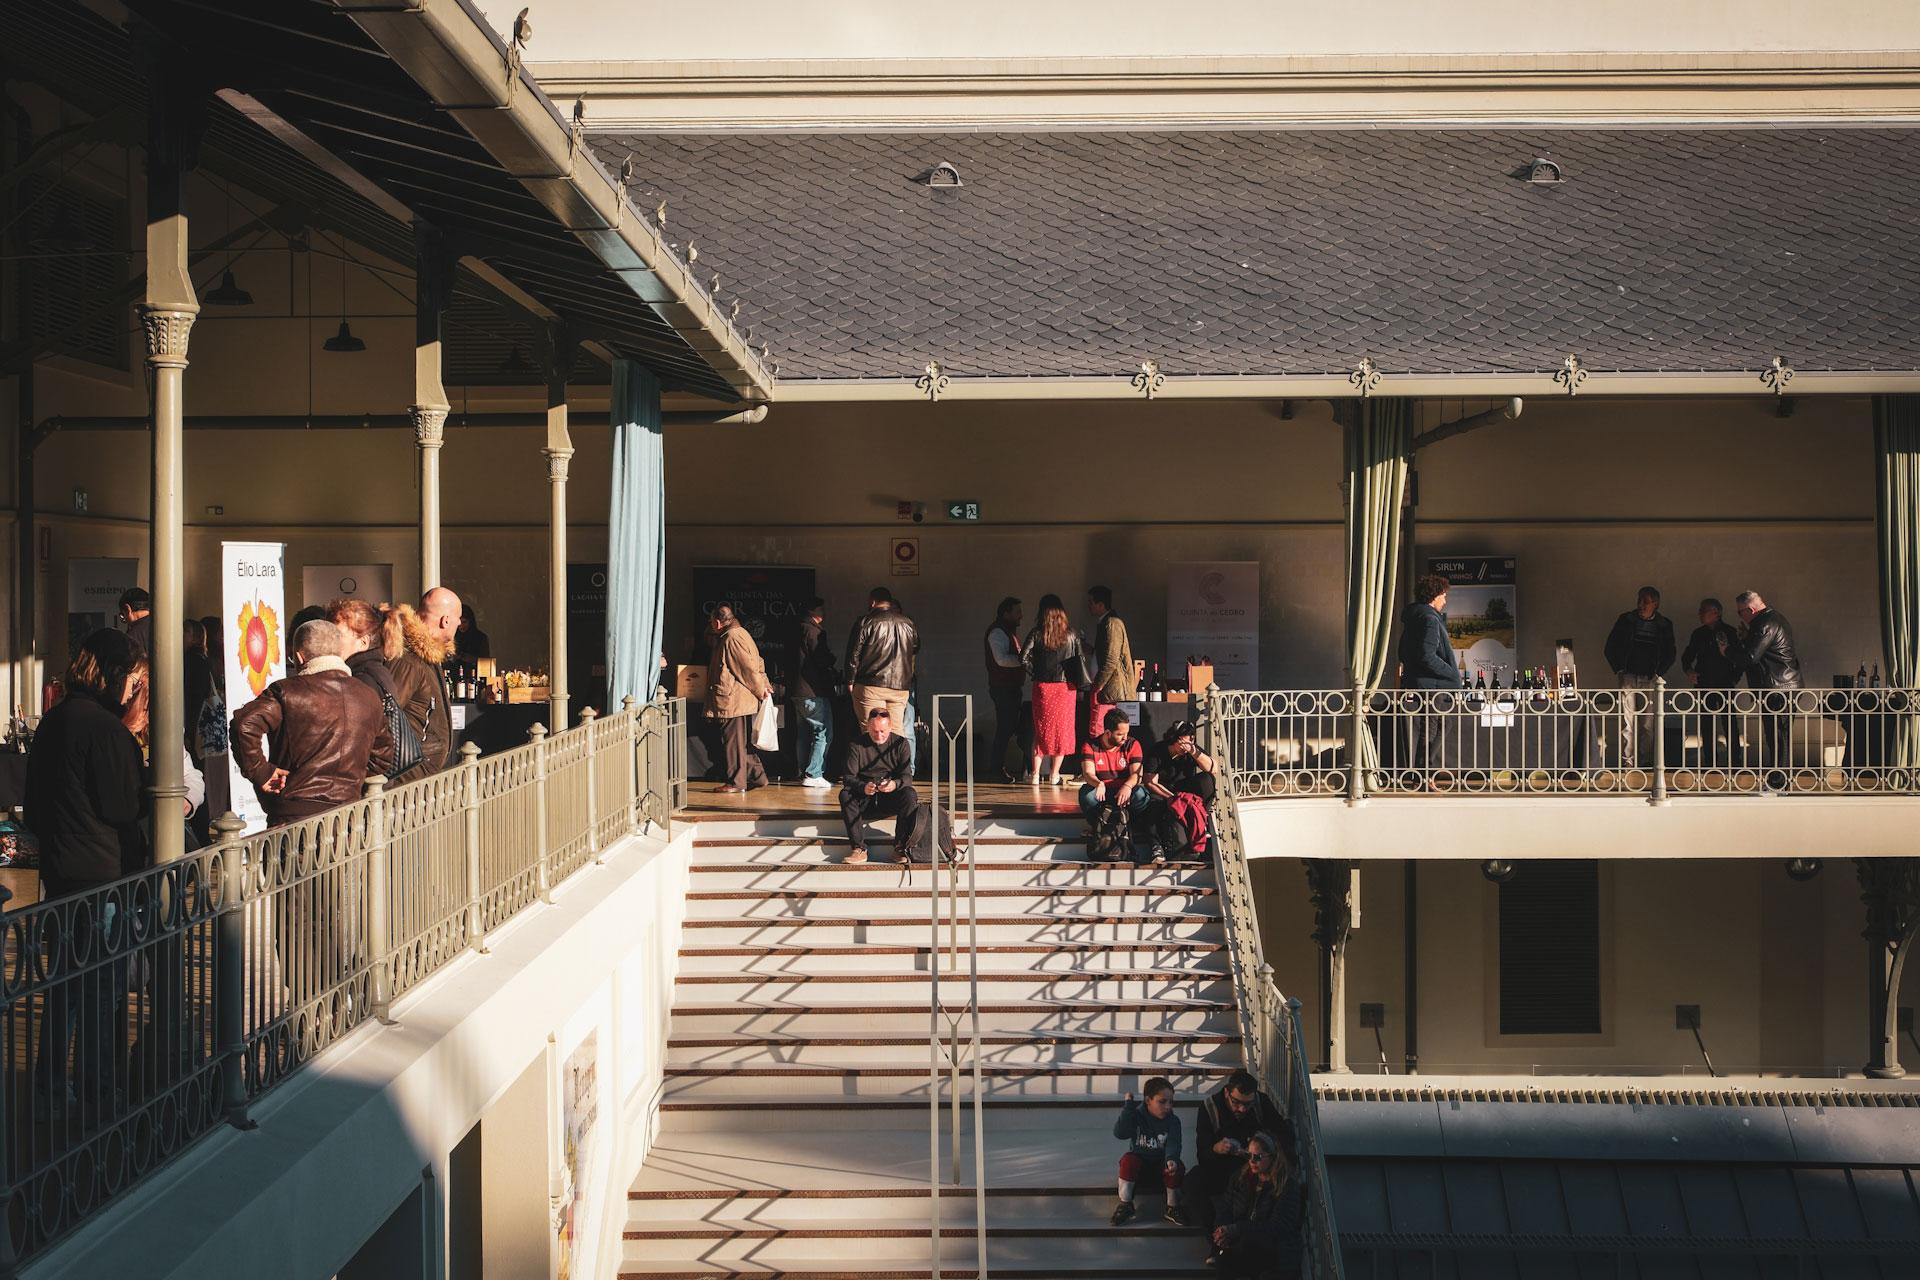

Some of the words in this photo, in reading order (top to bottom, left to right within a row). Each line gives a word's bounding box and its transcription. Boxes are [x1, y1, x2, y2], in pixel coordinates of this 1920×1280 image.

[237, 558, 254, 577] Élio
[255, 562, 276, 577] Lara
[1436, 562, 1465, 571] SIRLYN
[765, 591, 784, 600] DAS
[1180, 608, 1208, 617] QUINTA
[1219, 608, 1245, 616] CEDRO
